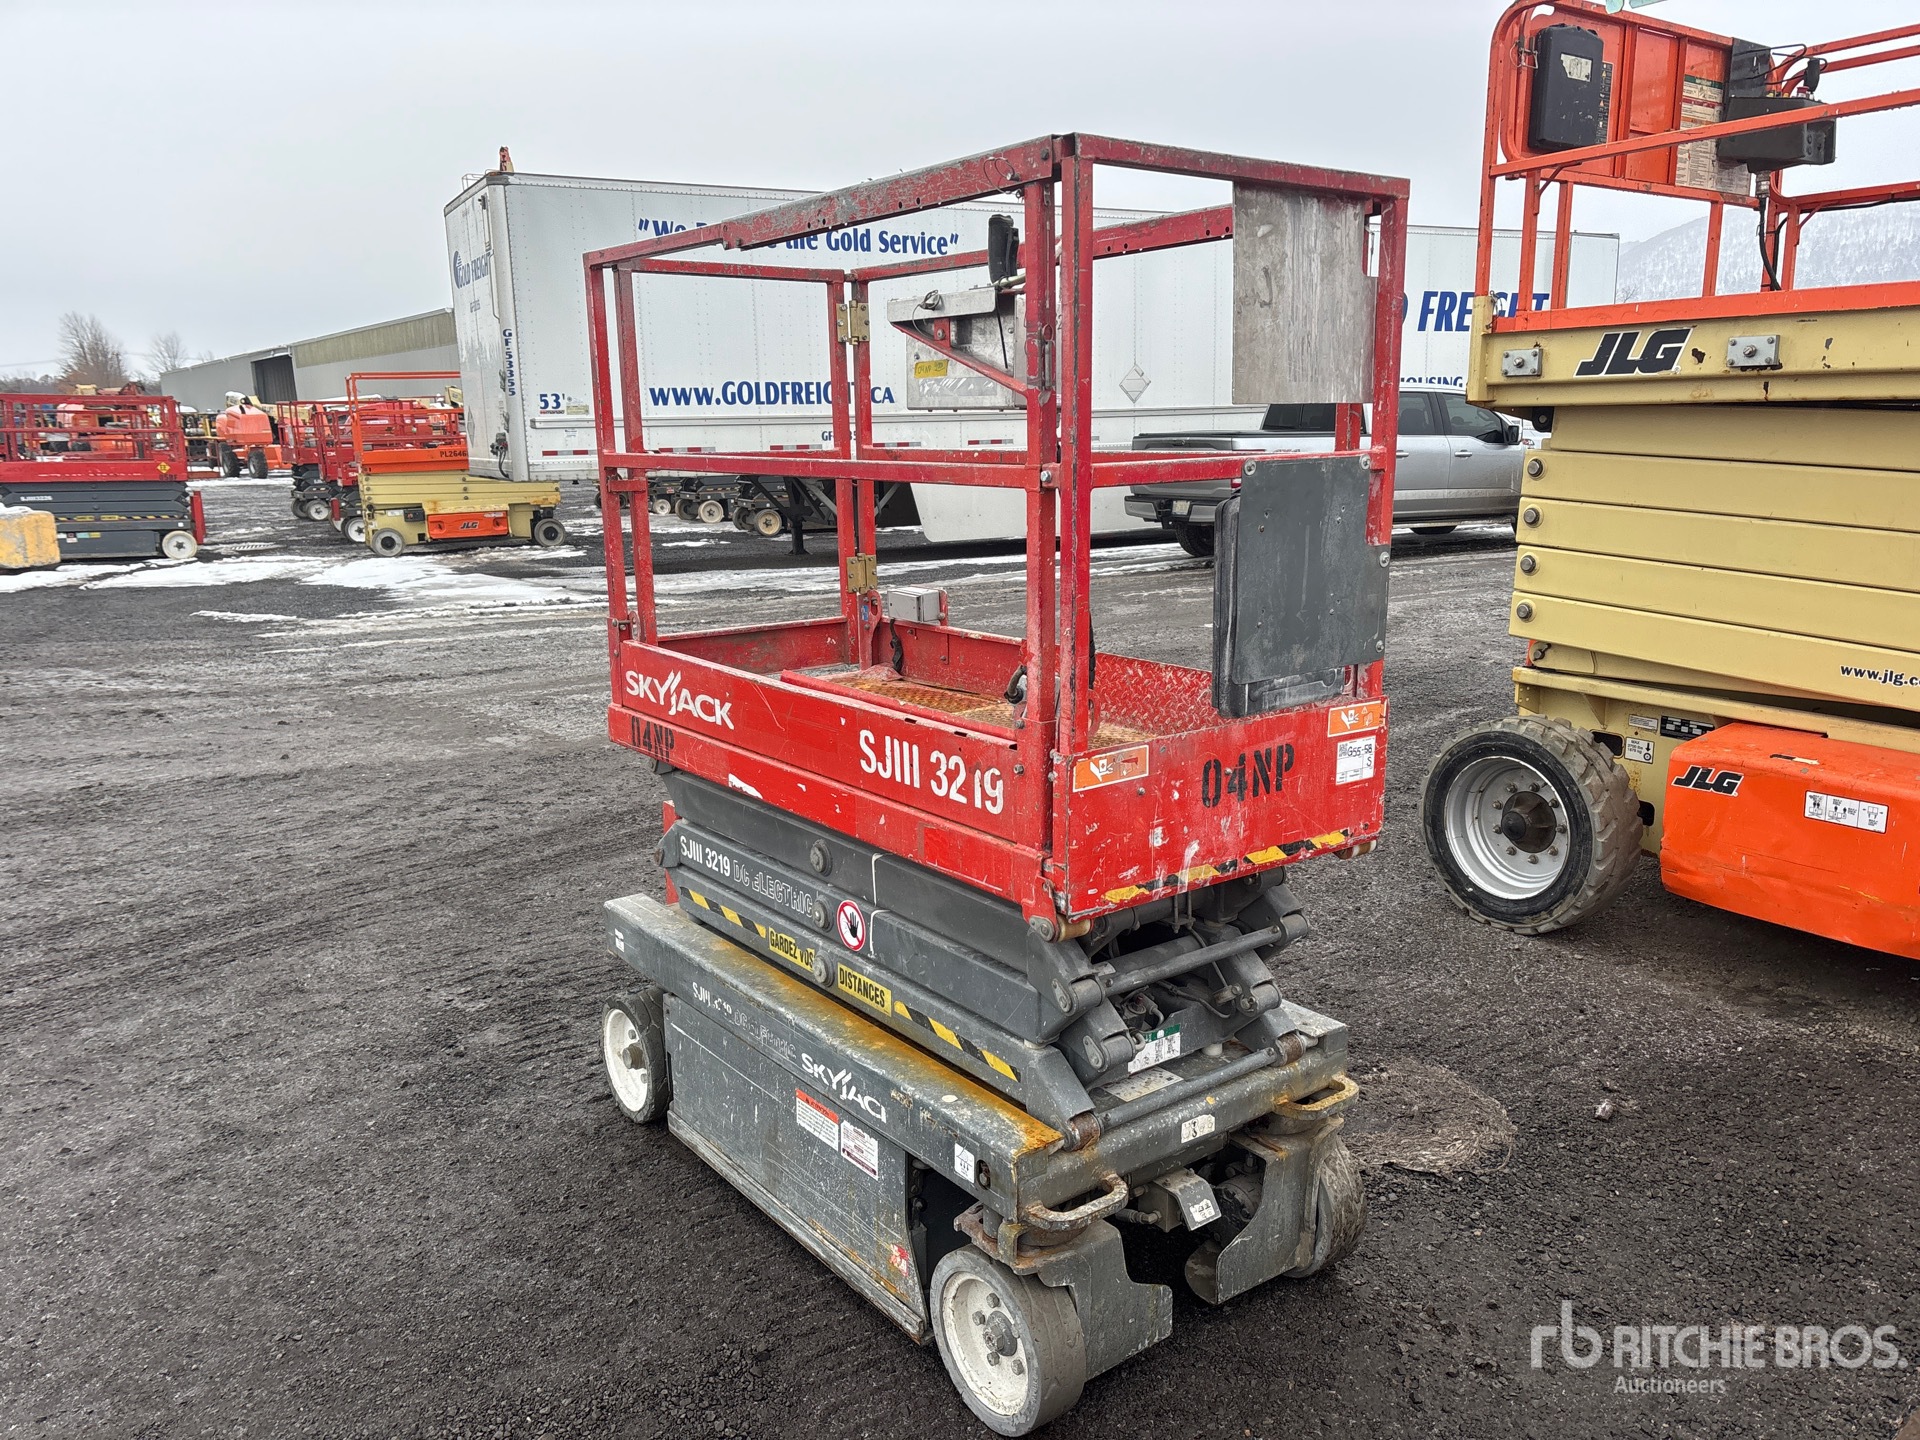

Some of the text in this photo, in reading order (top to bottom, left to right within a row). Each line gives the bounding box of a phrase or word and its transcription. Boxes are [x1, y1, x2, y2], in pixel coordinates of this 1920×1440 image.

[826, 228, 871, 252] Gold
[1574, 328, 1693, 377] JLG
[459, 521, 479, 530] JLG
[1840, 665, 1920, 686] www.jlg.c
[625, 669, 735, 731] SKYJACK
[930, 750, 1004, 815] 3219
[1673, 766, 1743, 795] JLG
[704, 847, 731, 877] 3219
[768, 927, 886, 1008] GARDEZ VOS DISTANCES
